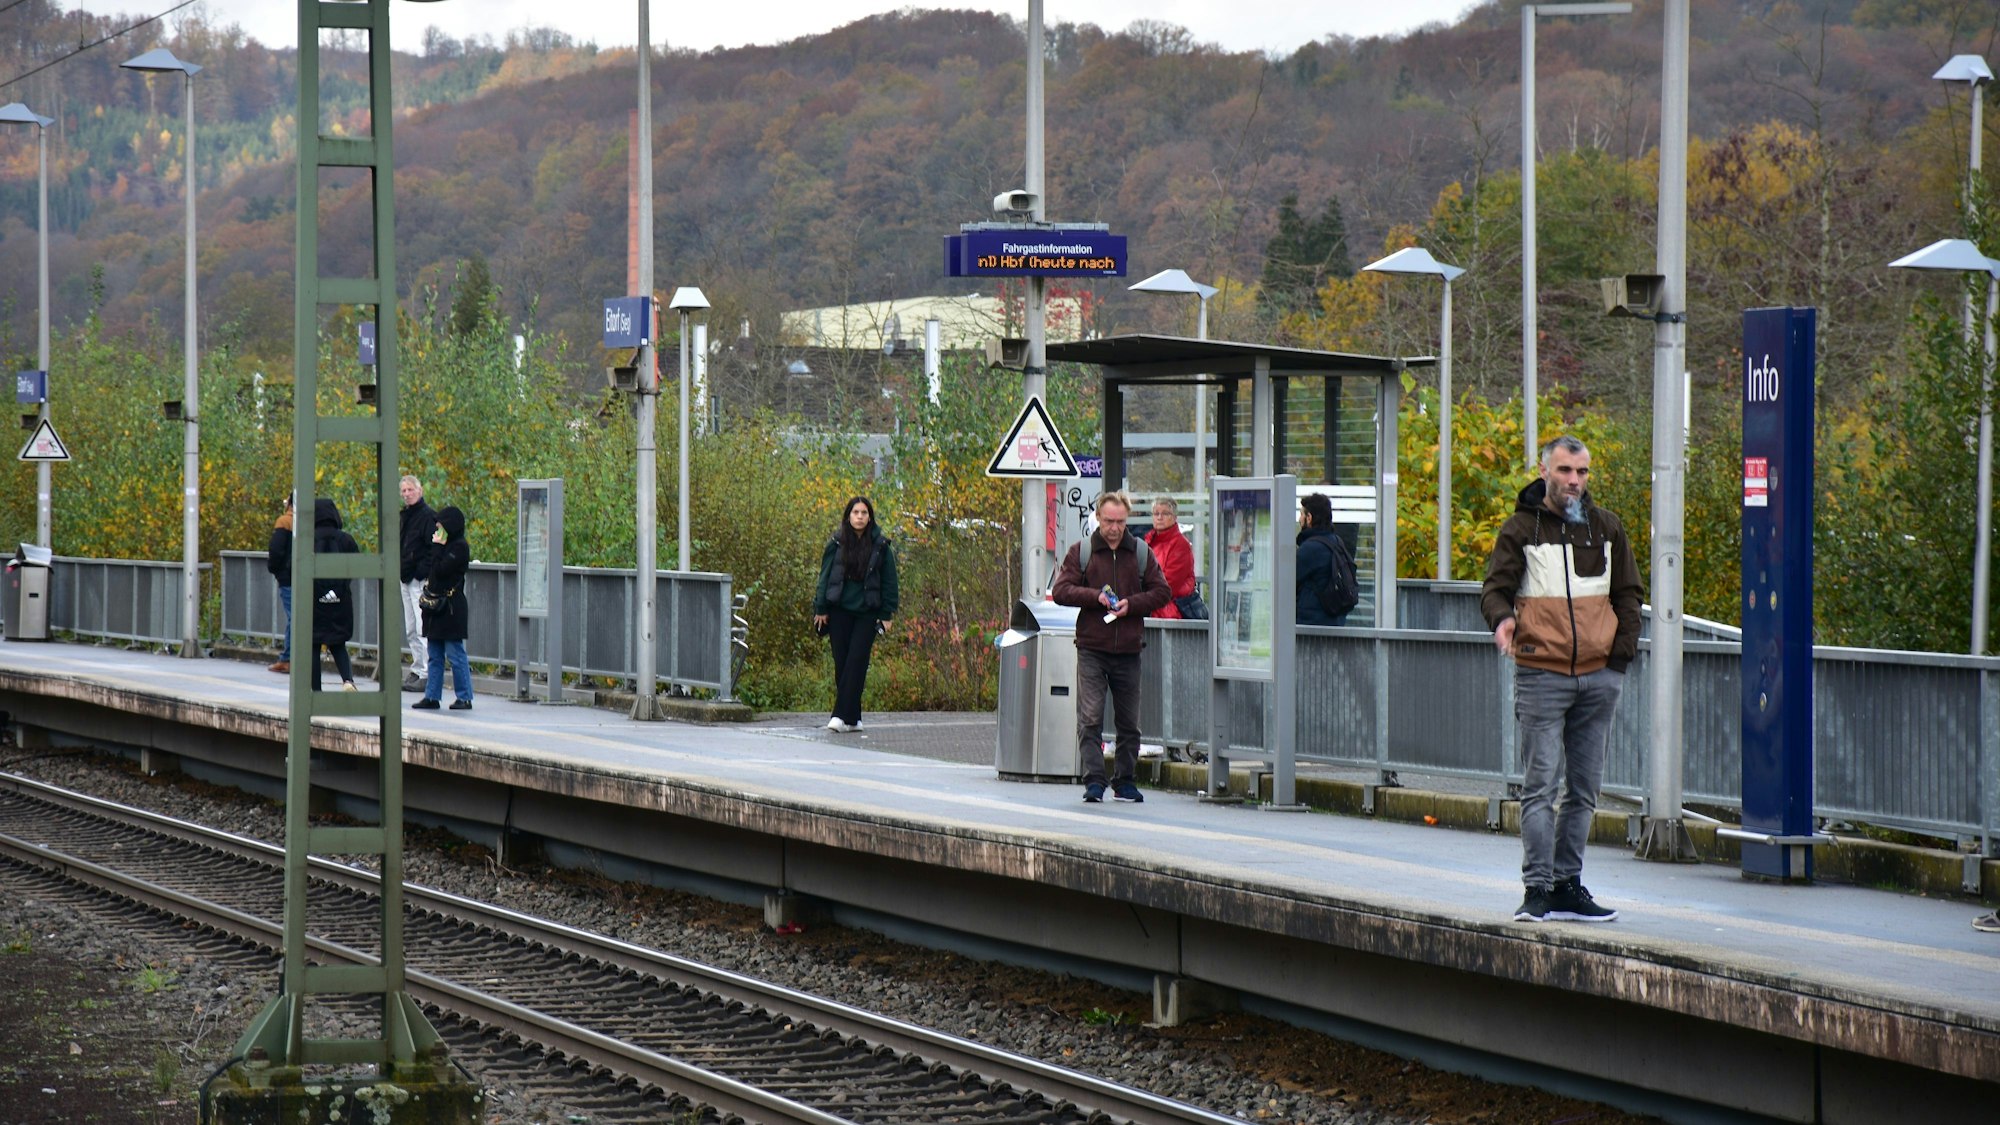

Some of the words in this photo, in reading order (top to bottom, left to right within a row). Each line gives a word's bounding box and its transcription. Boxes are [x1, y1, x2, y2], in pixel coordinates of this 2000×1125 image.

[1002, 243, 1093, 255] Fahrgastinformation
[1000, 255, 1026, 268] Hbf
[1029, 255, 1076, 269] (heute
[1079, 256, 1116, 269] nach
[1748, 353, 1779, 402] Info
